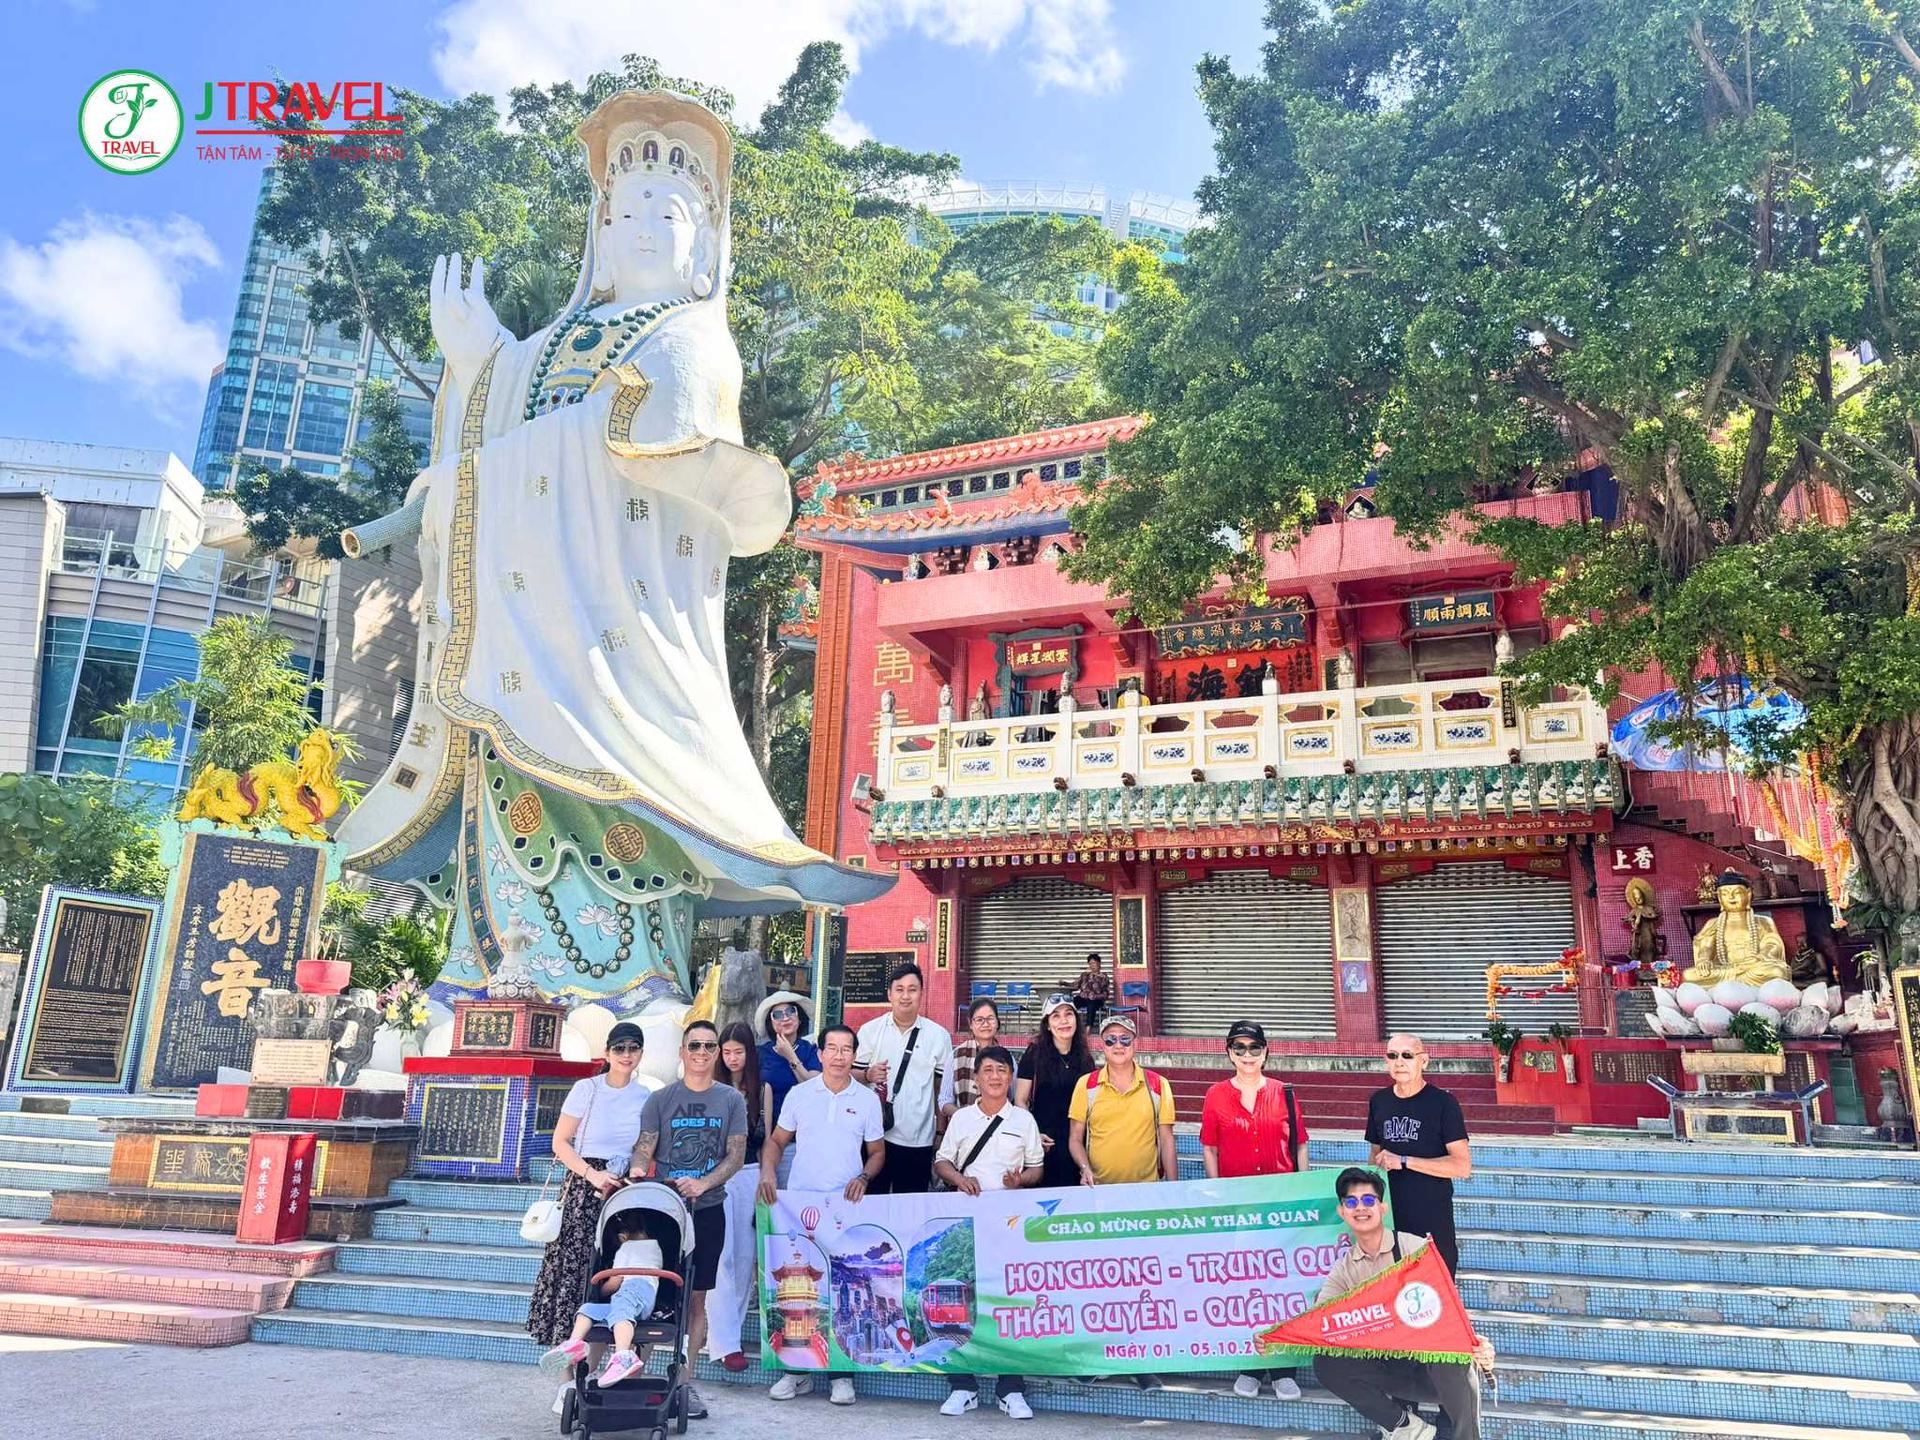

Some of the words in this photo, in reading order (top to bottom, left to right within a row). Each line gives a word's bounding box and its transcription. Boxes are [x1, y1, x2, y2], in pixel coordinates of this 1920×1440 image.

[201, 878, 281, 1018] 觀音
[672, 1103, 707, 1116] AIR
[671, 1118, 706, 1128] GOES
[709, 1118, 722, 1128] IN
[1048, 1219, 1095, 1235] CHÀO
[1100, 1217, 1151, 1232] MỪNG
[1156, 1213, 1206, 1230] ĐOÀN
[1212, 1213, 1262, 1228] THAM
[1267, 1209, 1319, 1226] QUAN
[1005, 1256, 1162, 1295] HONGKONG
[1187, 1249, 1288, 1285] TRUNG
[993, 1295, 1075, 1340] THẨM
[1081, 1290, 1178, 1335] QUYẾN
[1203, 1289, 1307, 1329] QUẢNG
[1332, 1303, 1391, 1328] TRAVEL
[1105, 1342, 1146, 1358] NGÀY
[1153, 1344, 1171, 1357] 01
